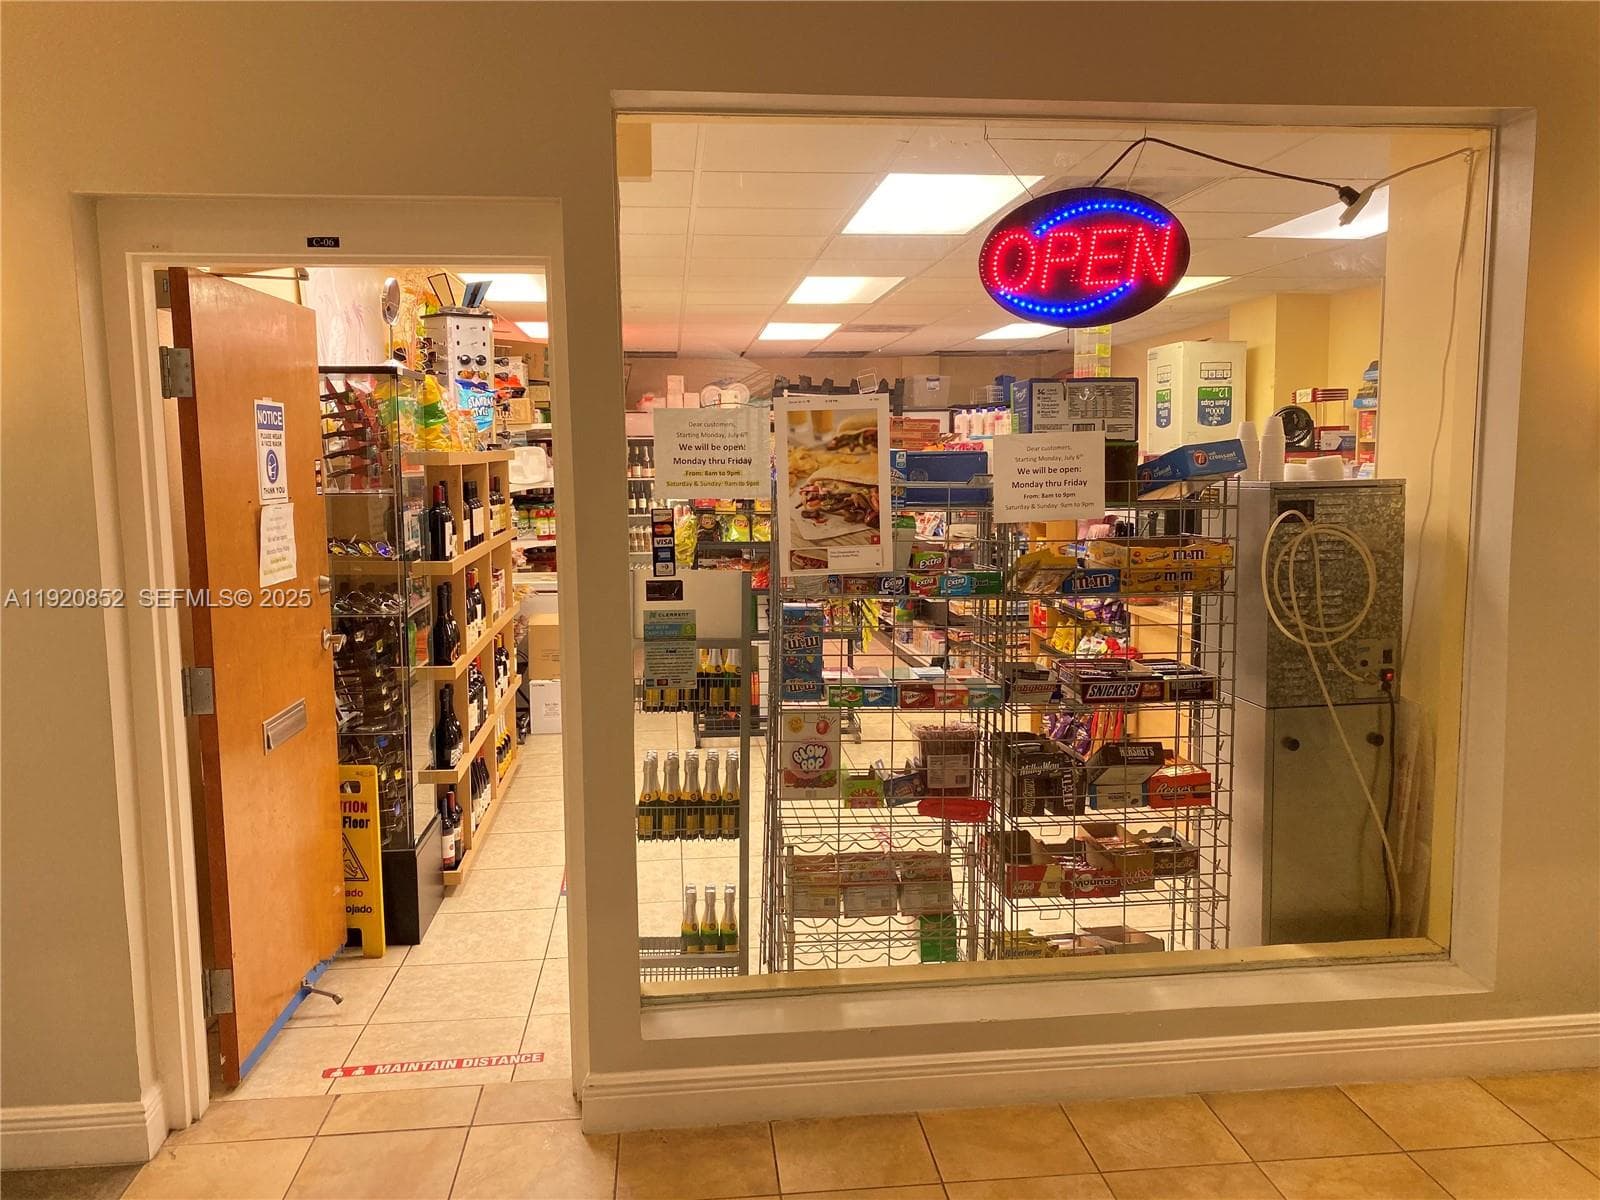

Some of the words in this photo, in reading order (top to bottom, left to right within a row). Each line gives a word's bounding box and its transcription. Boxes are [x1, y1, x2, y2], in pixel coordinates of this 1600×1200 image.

[312, 238, 334, 246] C-06
[992, 224, 1173, 293] OPEN
[257, 410, 282, 426] NOTICE
[673, 457, 706, 466] Monday
[728, 457, 752, 466] Friday
[1012, 480, 1044, 489] Monday
[920, 556, 942, 568] Extra
[884, 578, 903, 588] Extra
[916, 577, 933, 588] Extra
[946, 576, 965, 586] Extra
[1088, 683, 1140, 698] SNICKERS
[793, 745, 826, 763] BLOW
[801, 758, 824, 770] POP
[340, 800, 368, 813] TION
[343, 816, 370, 829] Floor
[345, 888, 363, 897] ado
[346, 904, 373, 915] ojado
[374, 1059, 458, 1074] MAINTAIN
[462, 1053, 543, 1068] DISTANCE
